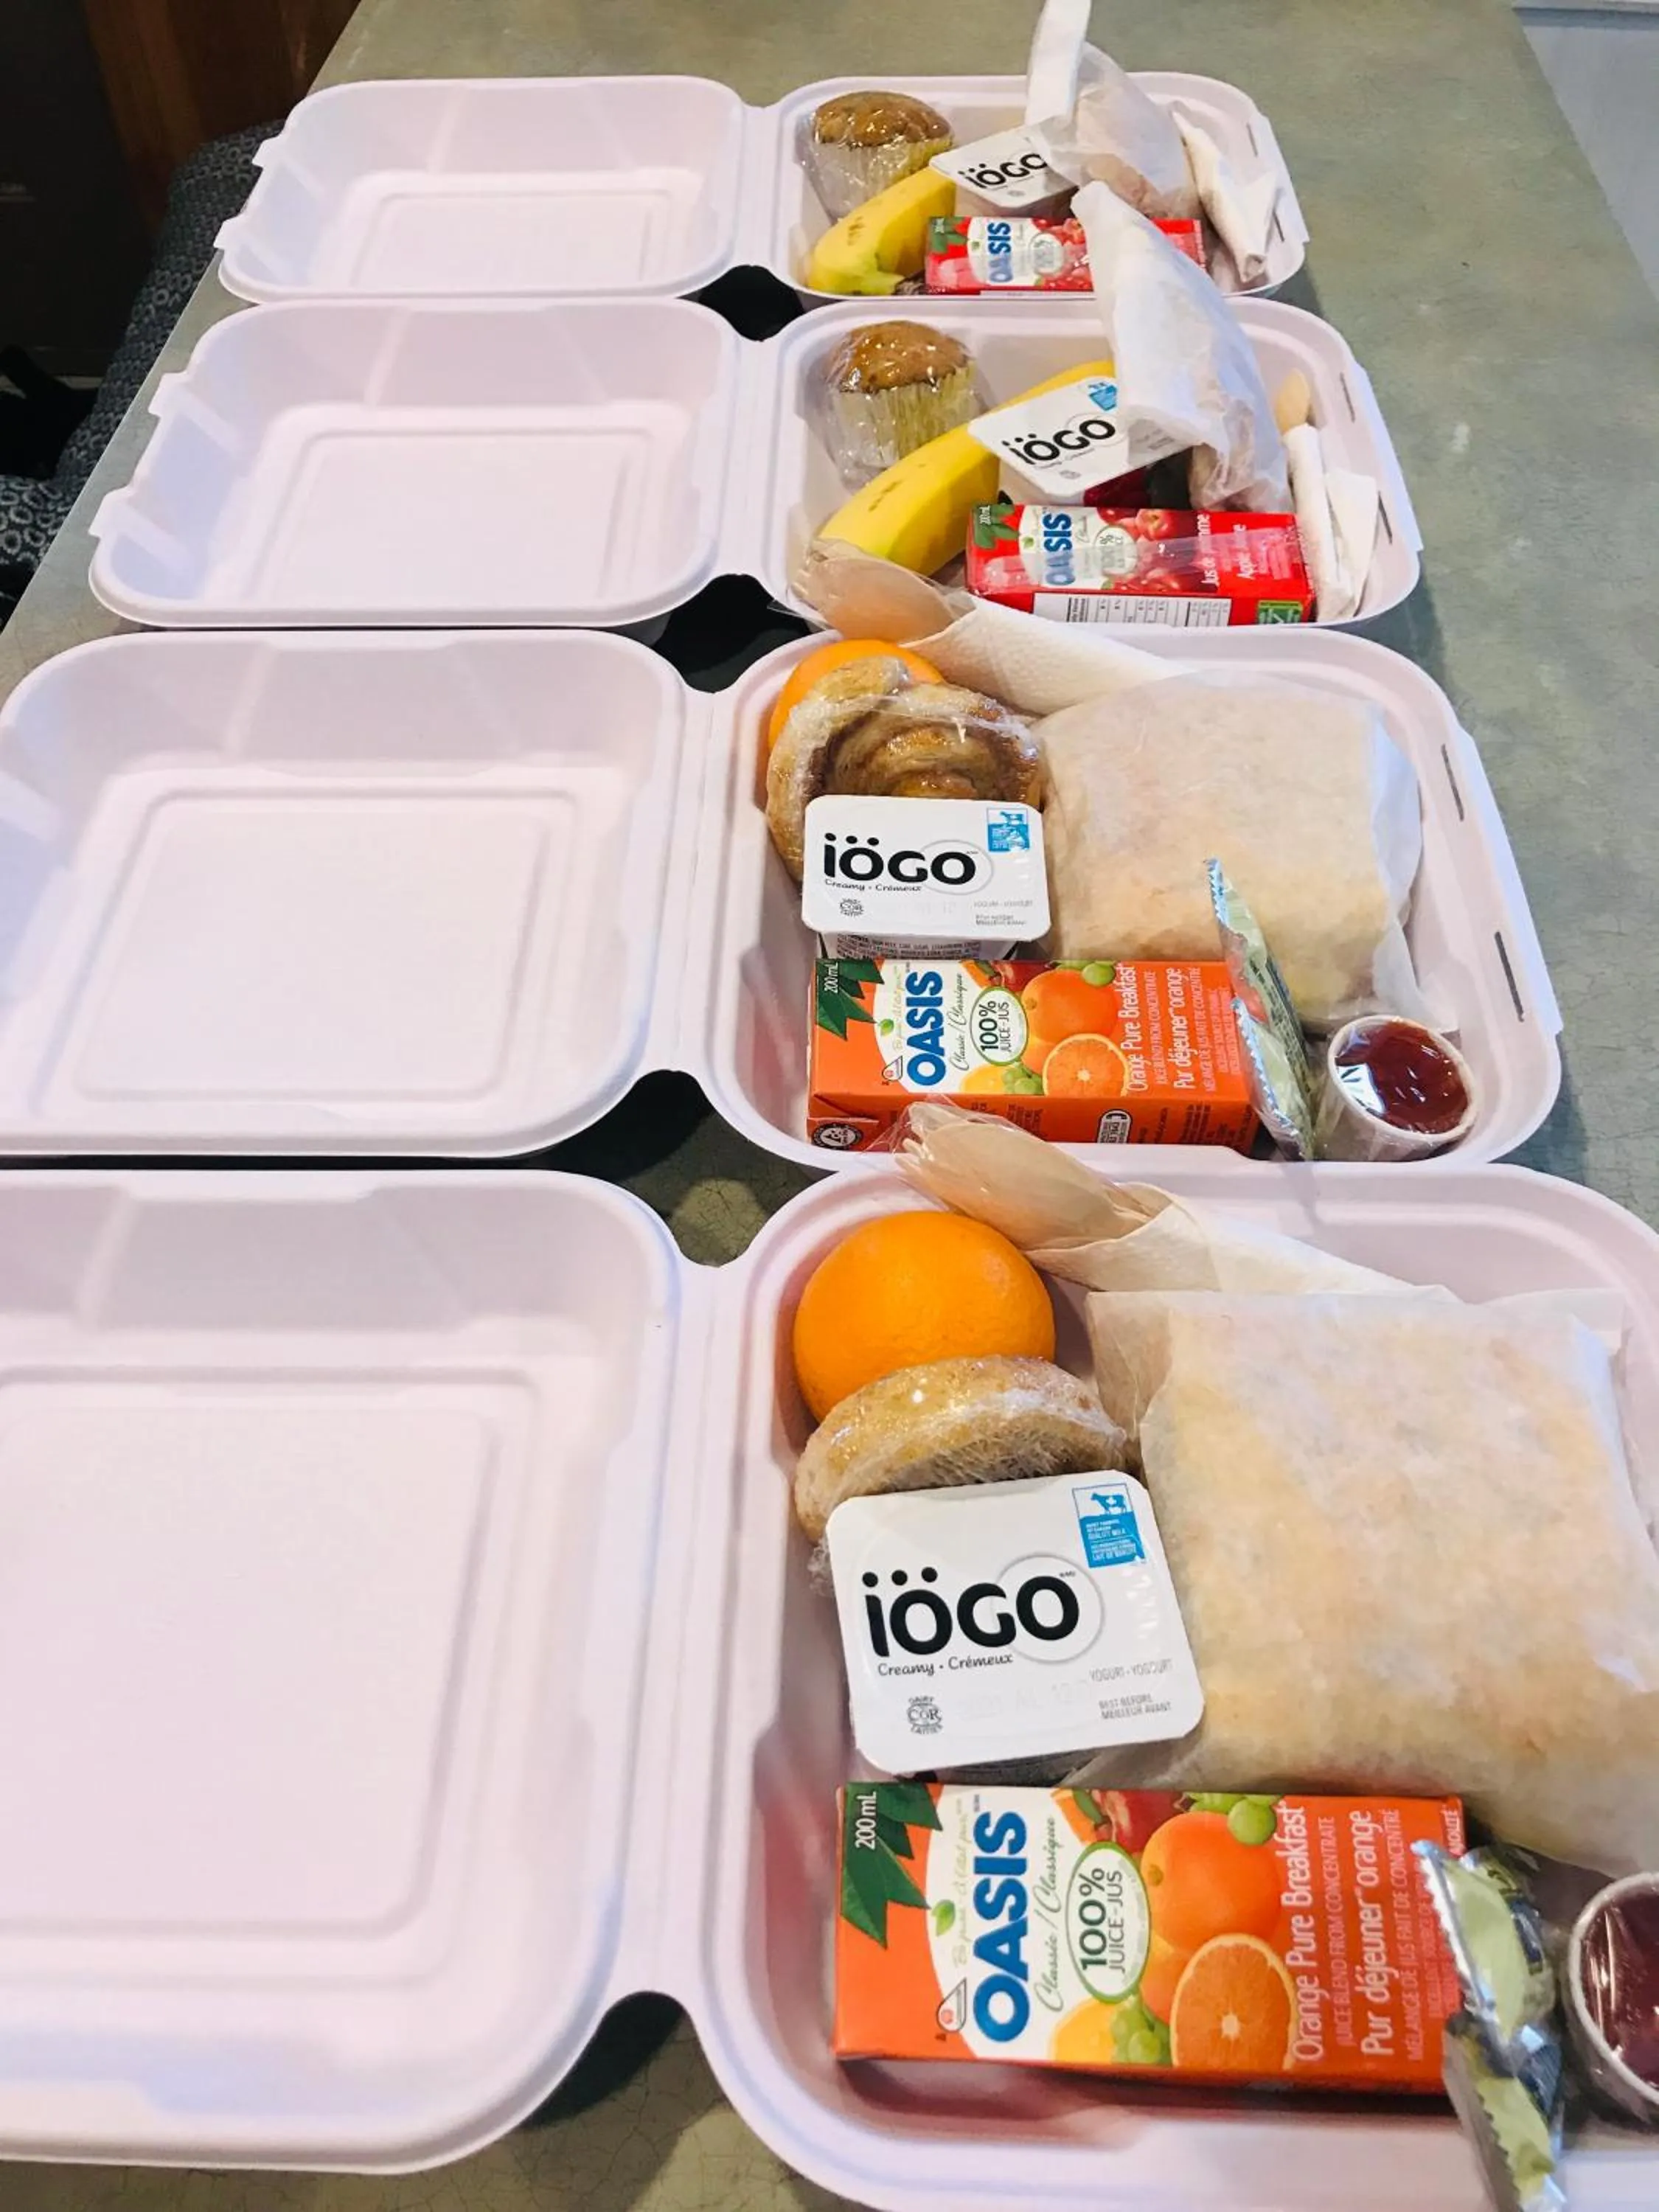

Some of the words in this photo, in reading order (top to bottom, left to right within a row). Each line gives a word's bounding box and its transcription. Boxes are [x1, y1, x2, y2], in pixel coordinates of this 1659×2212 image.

[1042, 513, 1076, 585] OASIS
[947, 973, 968, 1026] Classique
[1113, 967, 1141, 1018] Breakfast
[1166, 967, 1190, 1008] orange
[905, 971, 946, 1086] OASIS
[978, 1001, 999, 1051] 100%
[1120, 1021, 1143, 1050] Pure
[950, 1034, 970, 1071] Classic
[1127, 1054, 1152, 1091] Orange
[1173, 1070, 1197, 1090] Pur
[877, 1662, 935, 1677] Creamy
[948, 1654, 1013, 1670] Crémeux
[1032, 1817, 1064, 1913] Classique
[1274, 1806, 1313, 1907] Breakfast
[1318, 1816, 1343, 1913] CONCENTRATE
[1349, 1810, 1383, 1888] orange
[1381, 1809, 1408, 1888] CONCENTRÉ
[1078, 1868, 1107, 1971] 100%
[1393, 1891, 1409, 1908] DE
[973, 1811, 1030, 2042] OASIS
[1285, 1914, 1318, 1968] Pure
[1328, 1916, 1346, 1955] FROM
[1395, 1913, 1414, 1941] FAIT
[1034, 1937, 1063, 2012] Classic
[1354, 1901, 1399, 2004] déjeuner
[1399, 1944, 1417, 1966] JUS
[1332, 1958, 1351, 2003] BLEND
[1400, 1969, 1417, 1987] DE
[1292, 1975, 1330, 2061] Orange
[1334, 2006, 1357, 2047] JUICE
[1361, 2011, 1394, 2056] Pur
